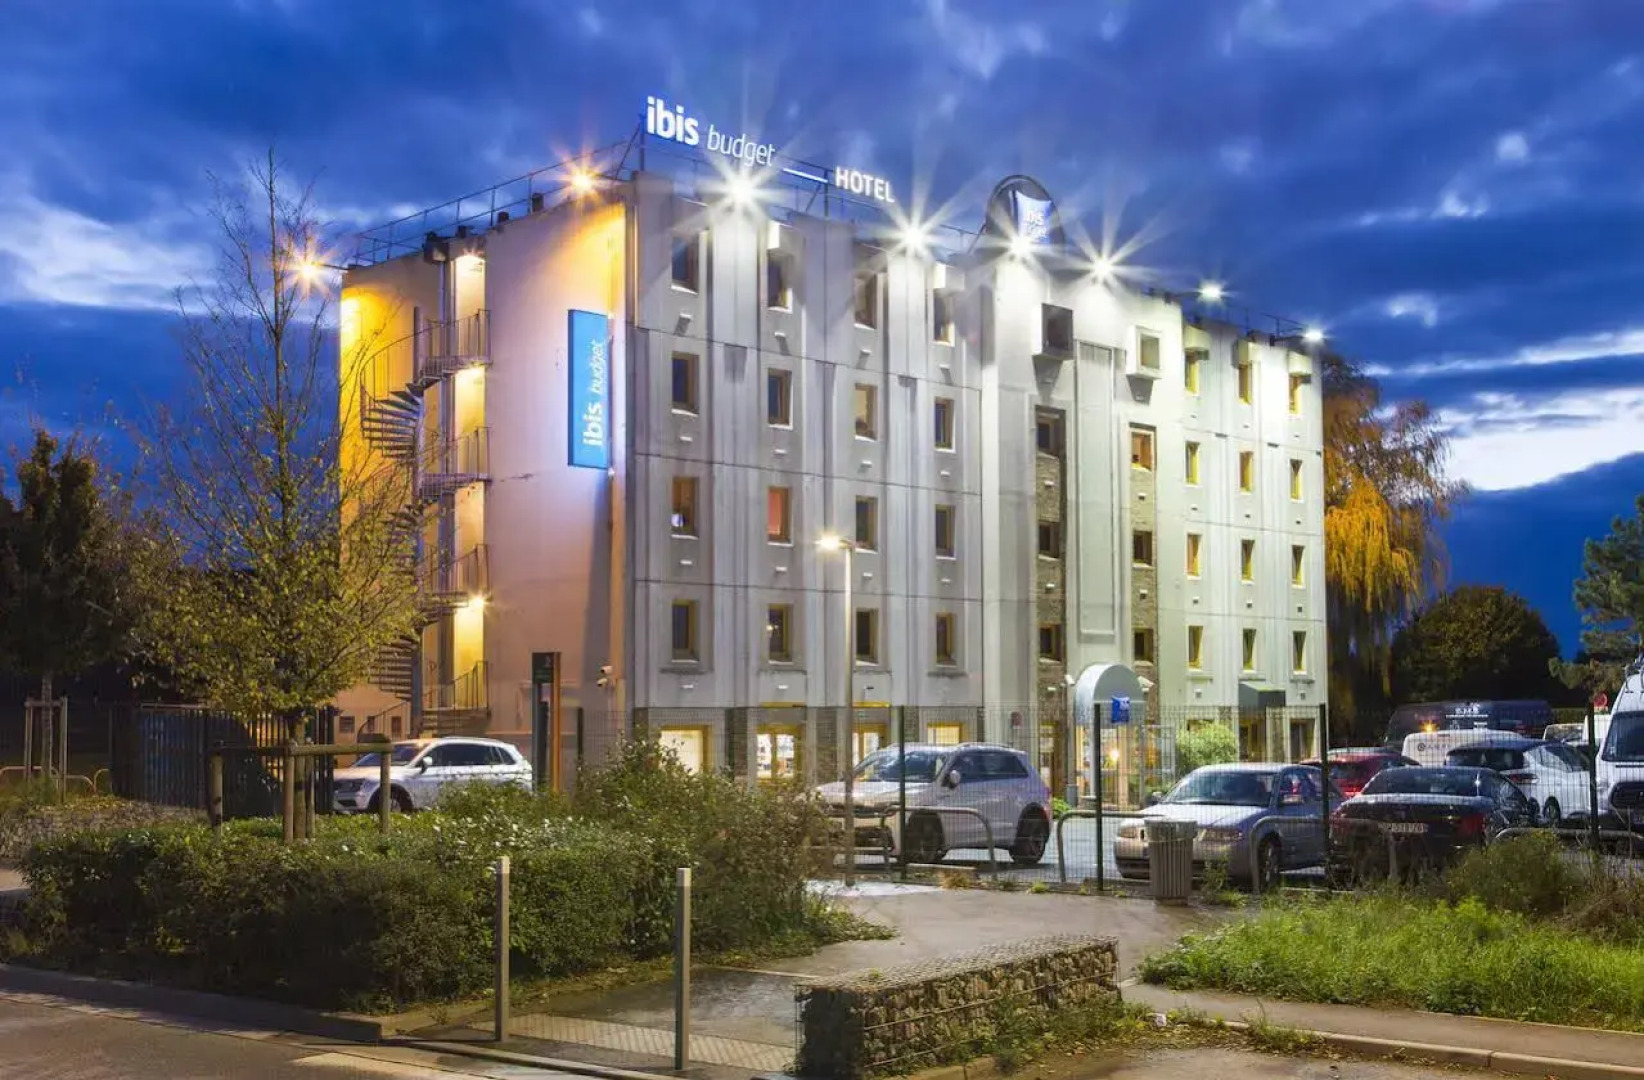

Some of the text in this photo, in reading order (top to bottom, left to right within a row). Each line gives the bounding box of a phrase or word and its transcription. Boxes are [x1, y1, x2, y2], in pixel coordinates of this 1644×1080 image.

[647, 96, 895, 203] ibis budget HOTEL
[582, 339, 607, 447] ibis budget
